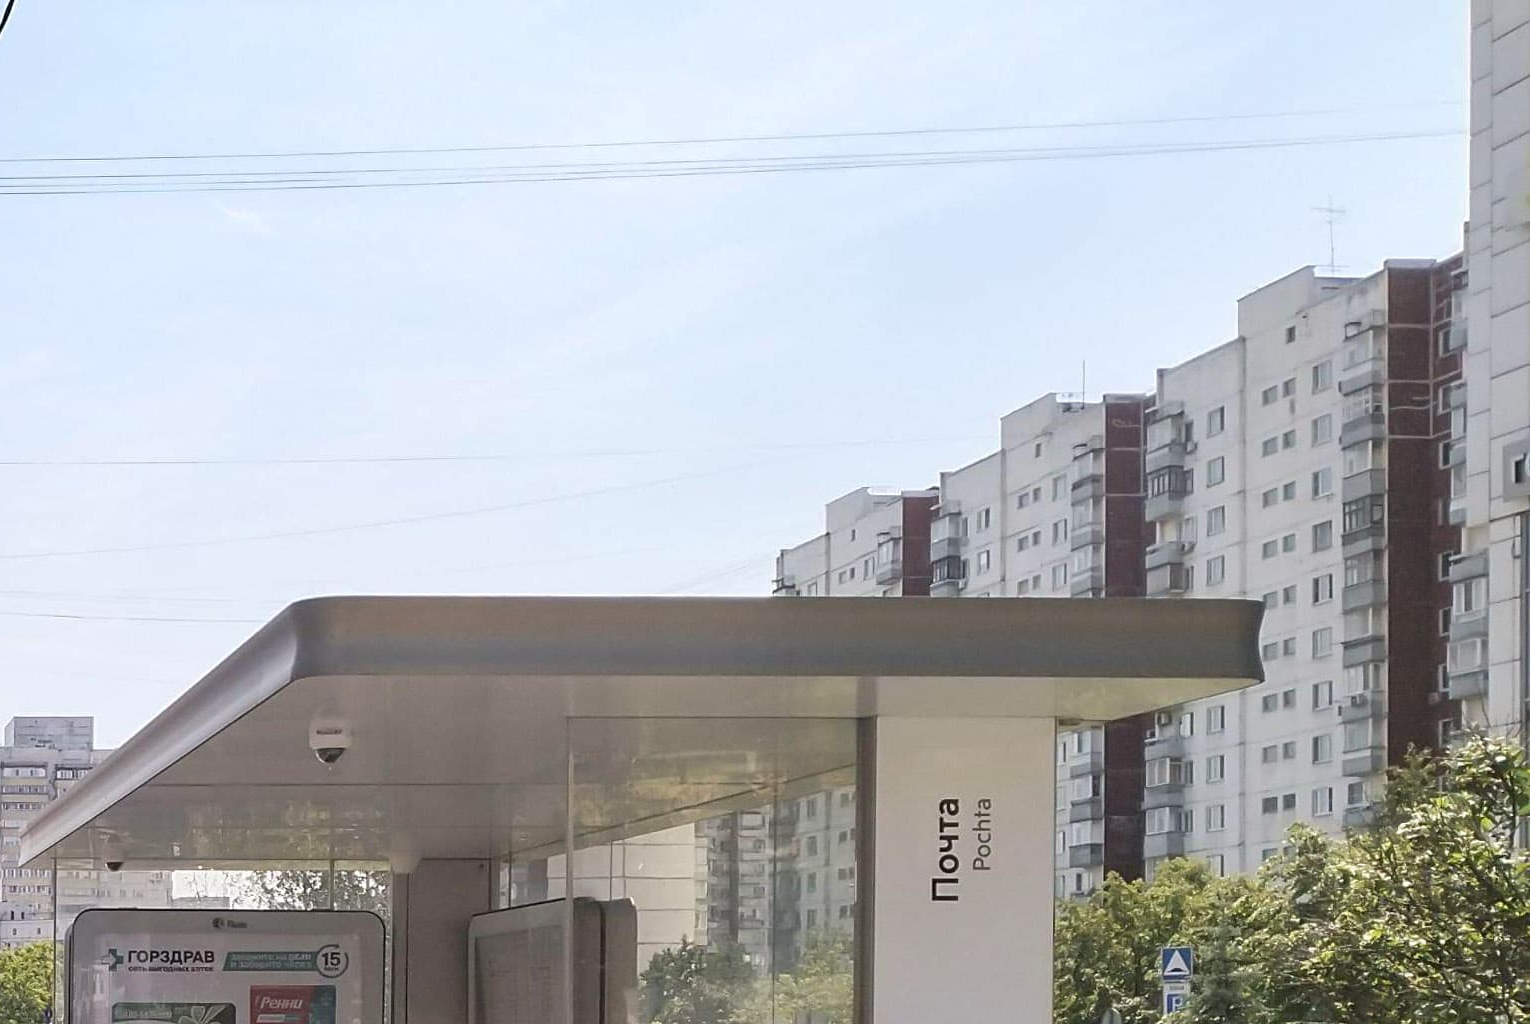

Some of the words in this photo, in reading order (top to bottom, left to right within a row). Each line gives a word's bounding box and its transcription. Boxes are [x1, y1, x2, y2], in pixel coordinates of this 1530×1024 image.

[972, 798, 992, 871] Pochta
[931, 798, 959, 901] Почта
[128, 950, 215, 965] ГОРЗДРАВ
[321, 952, 341, 966] 15
[260, 996, 304, 1010] Ренни
